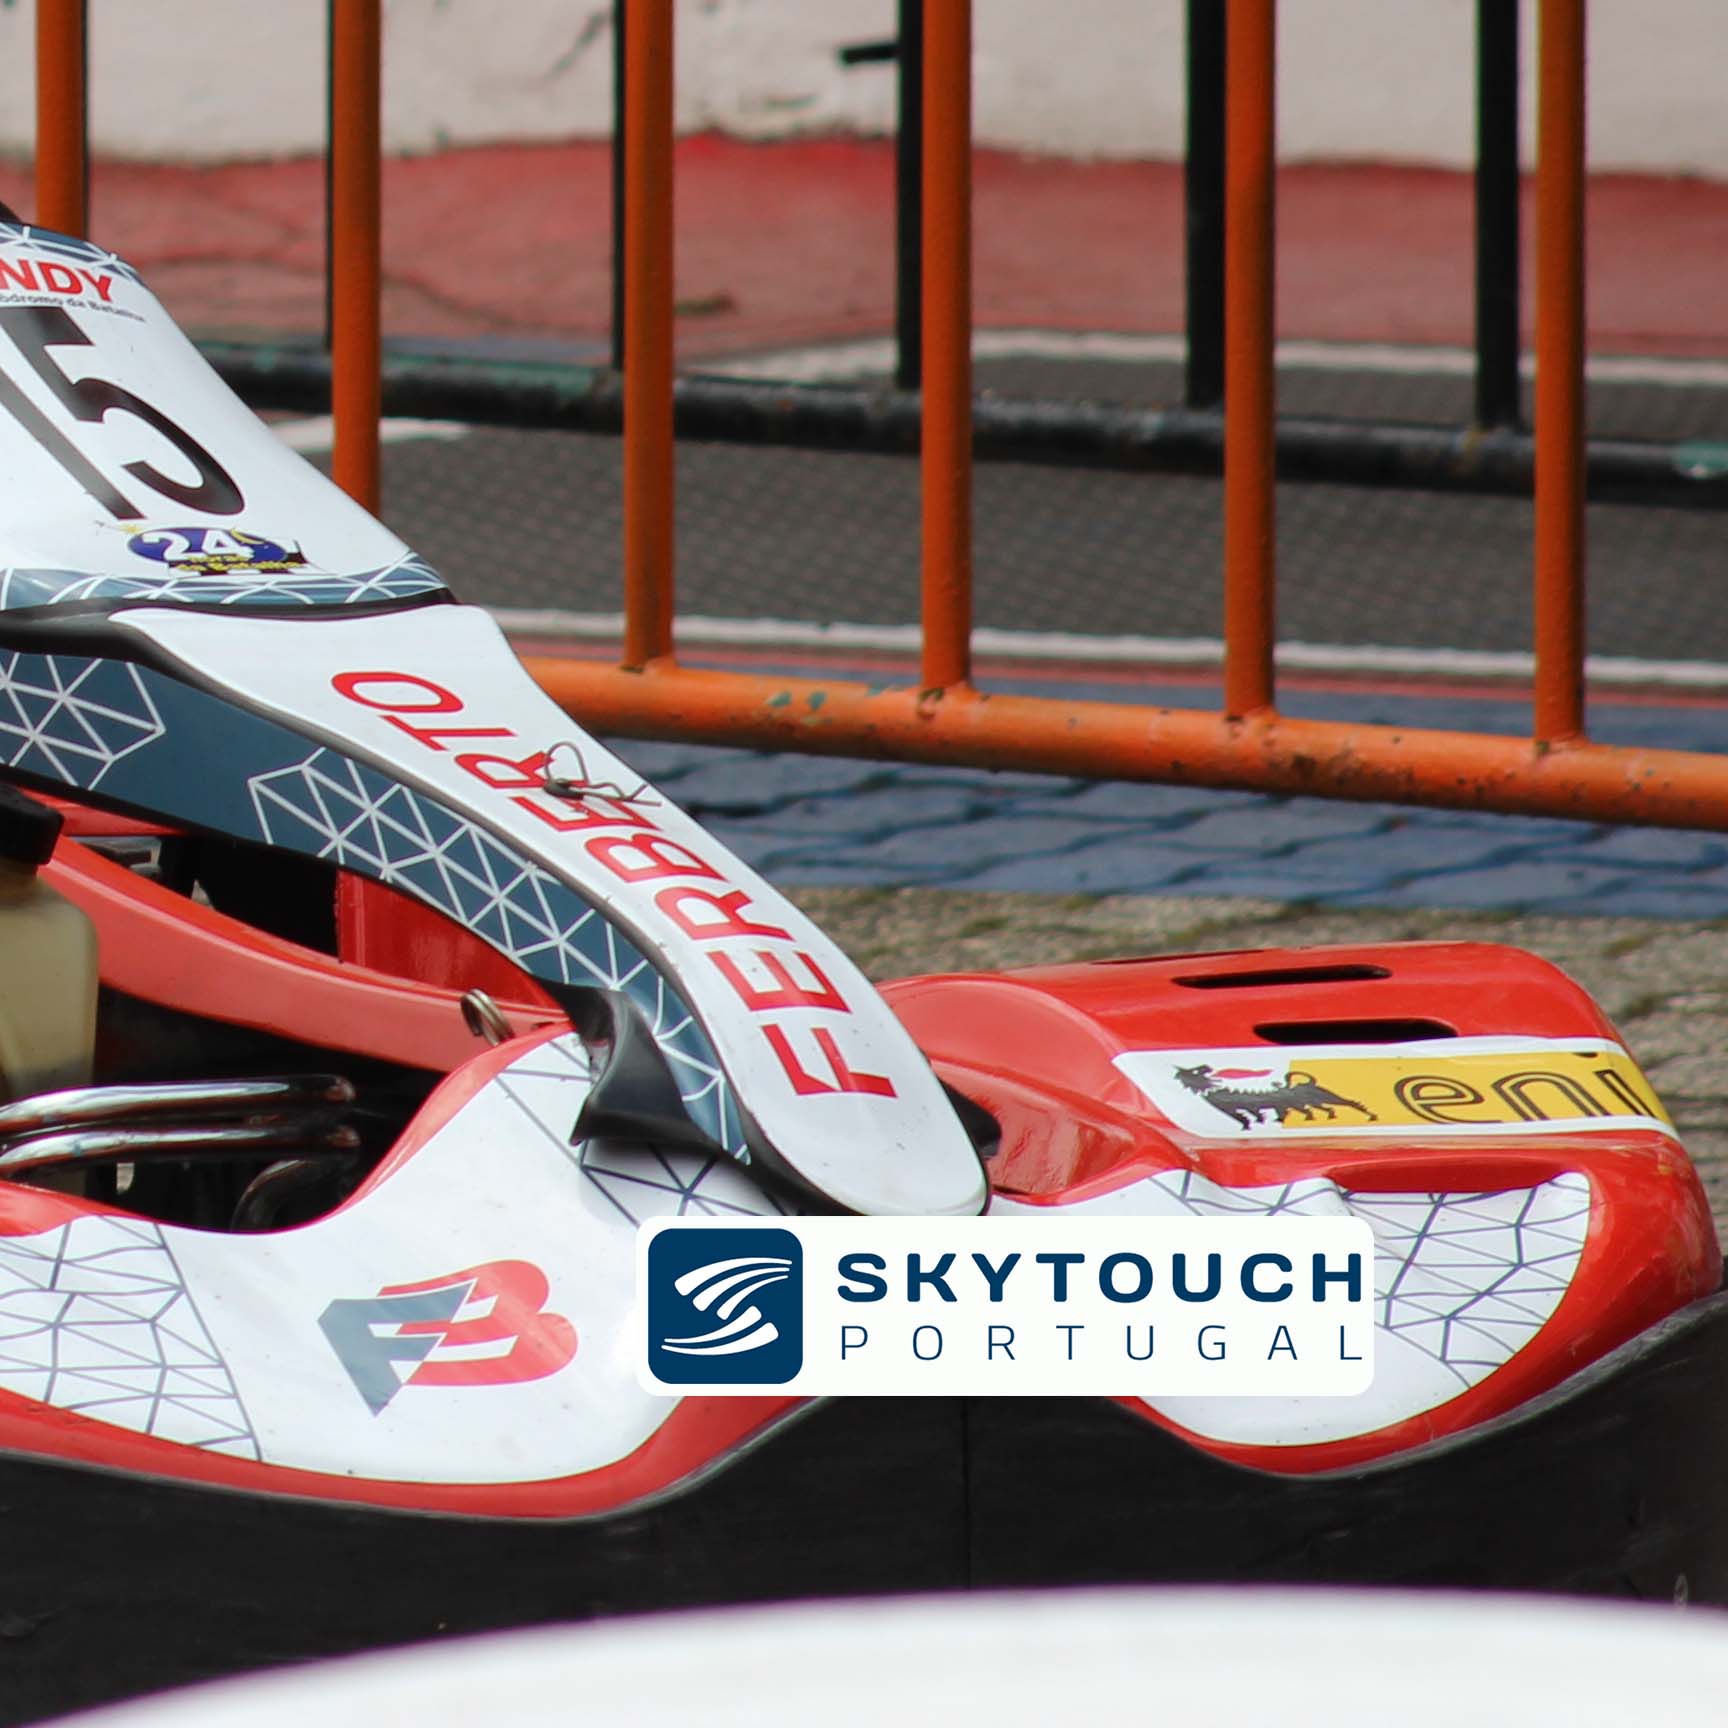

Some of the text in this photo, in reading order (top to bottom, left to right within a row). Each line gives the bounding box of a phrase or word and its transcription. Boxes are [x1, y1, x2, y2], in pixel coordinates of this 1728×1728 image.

[141, 529, 256, 561] 24
[330, 670, 900, 1100] FERBERTO
[1393, 1050, 1656, 1126] eni
